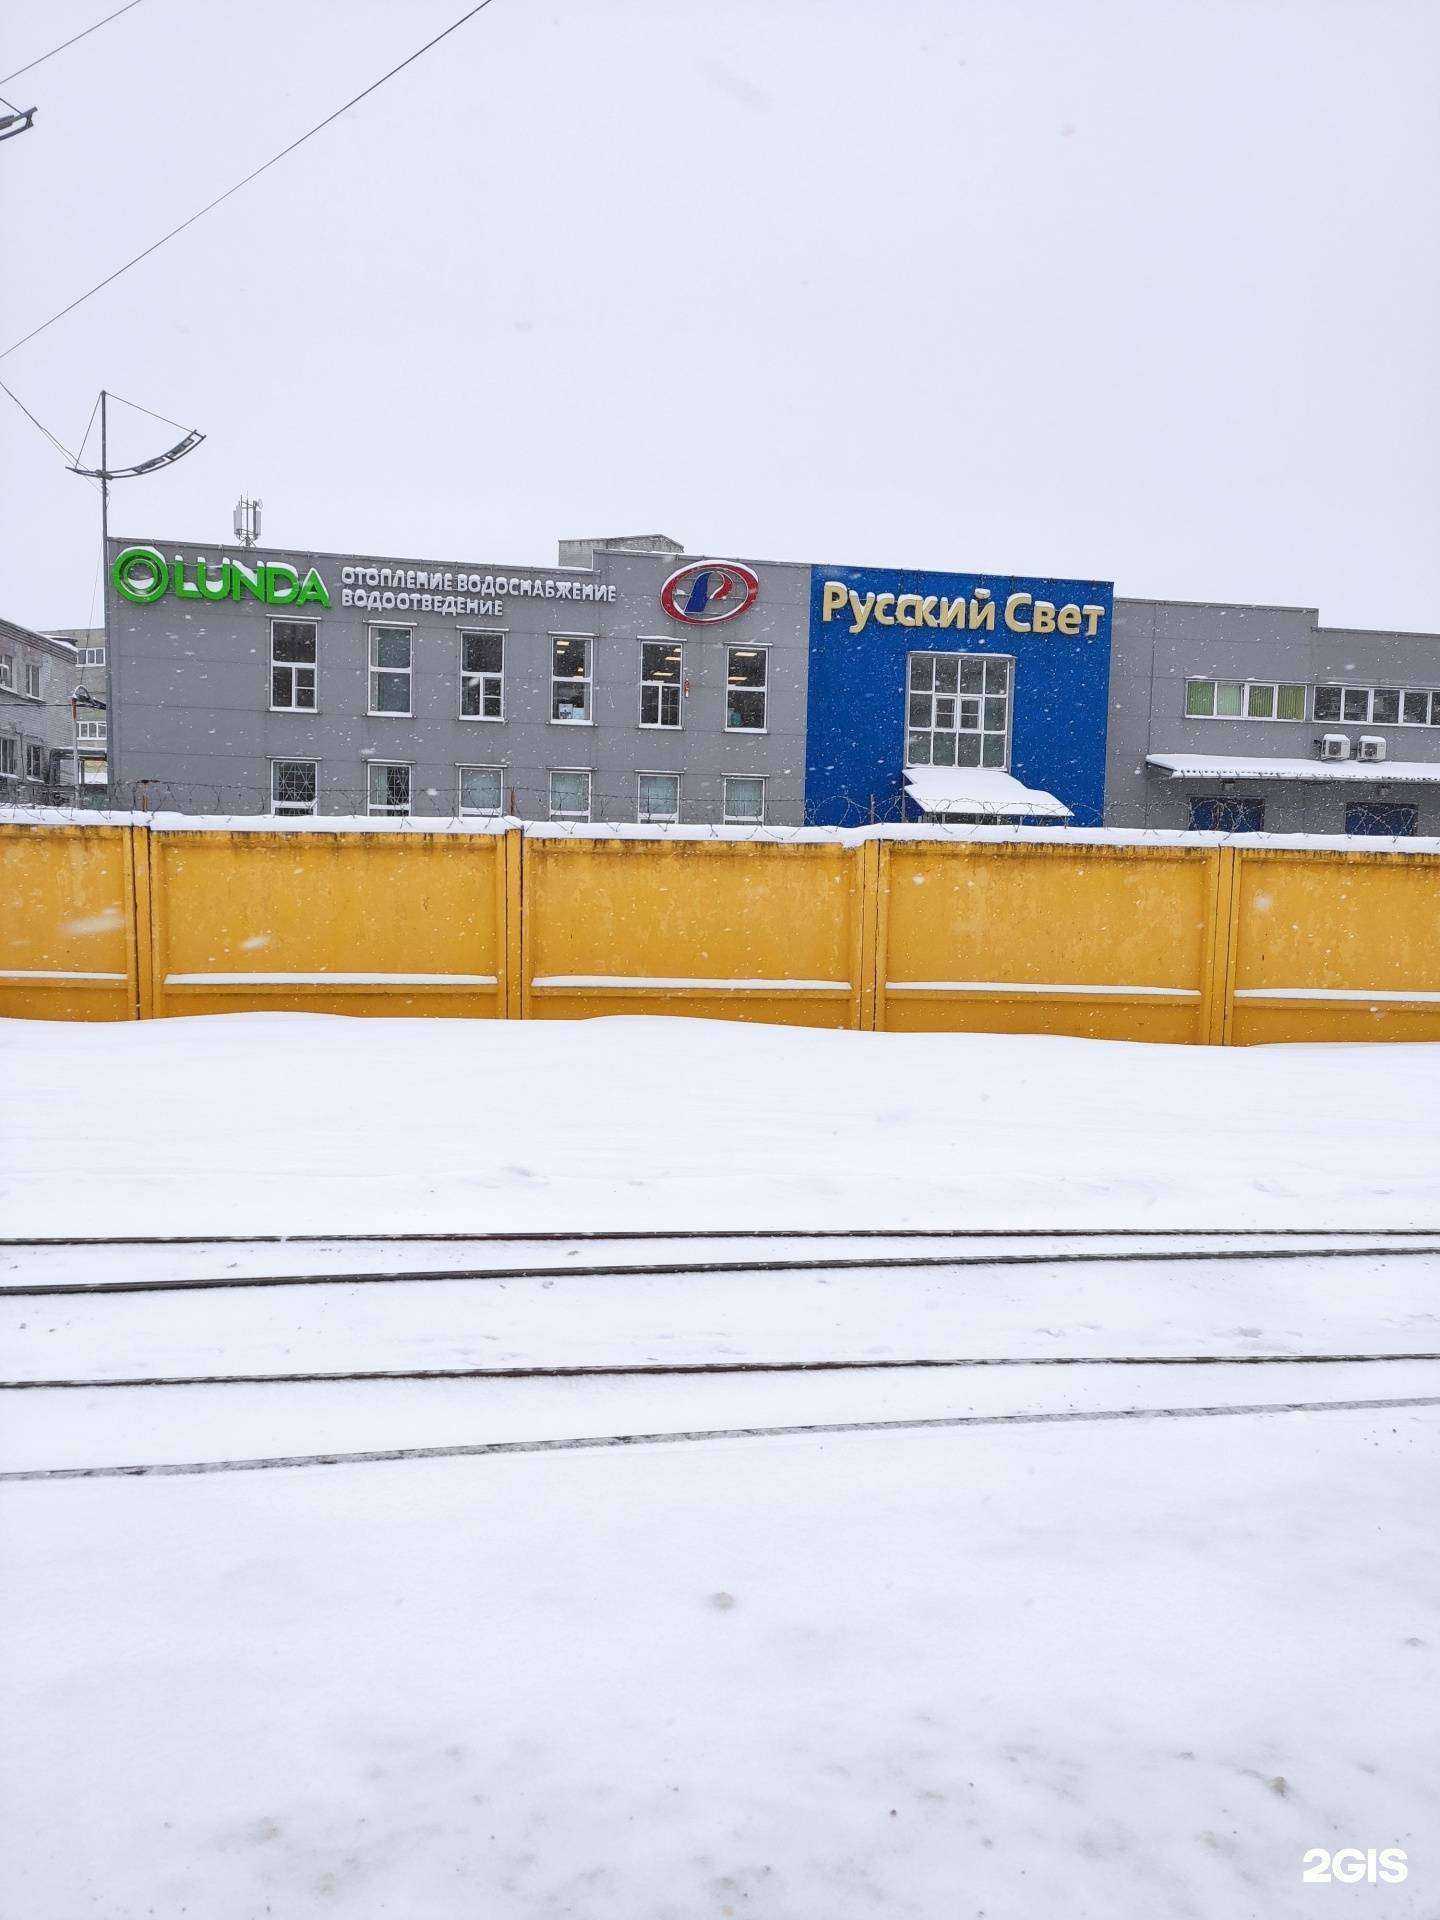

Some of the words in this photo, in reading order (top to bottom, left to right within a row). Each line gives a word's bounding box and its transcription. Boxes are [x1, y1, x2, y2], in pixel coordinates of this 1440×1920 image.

[341, 566, 453, 592] ОТОПЛЕНИЕ
[457, 573, 617, 602] ВОДОСНАБЖЕНИЕ
[341, 588, 503, 617] ВОДООТВЕДЕНИЕ
[823, 581, 996, 633] Русский
[1004, 592, 1106, 636] Свет
